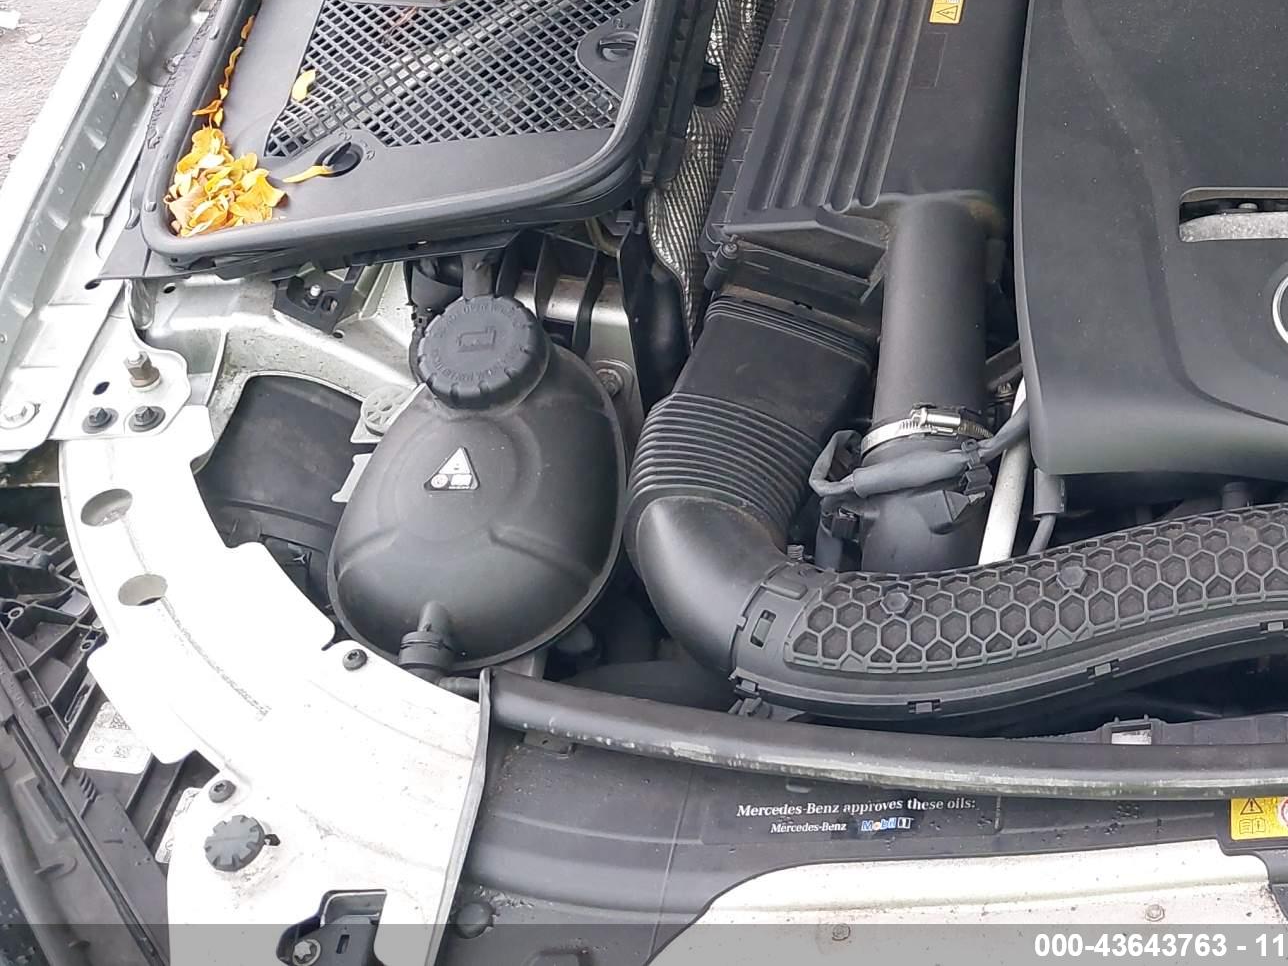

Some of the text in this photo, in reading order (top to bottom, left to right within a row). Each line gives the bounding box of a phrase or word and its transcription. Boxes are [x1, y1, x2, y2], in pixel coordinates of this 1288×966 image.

[737, 797, 976, 817] Mercedes-Benz approves these oils:
[770, 822, 847, 833] Mercedes-Benz
[861, 817, 897, 832] Mobil
